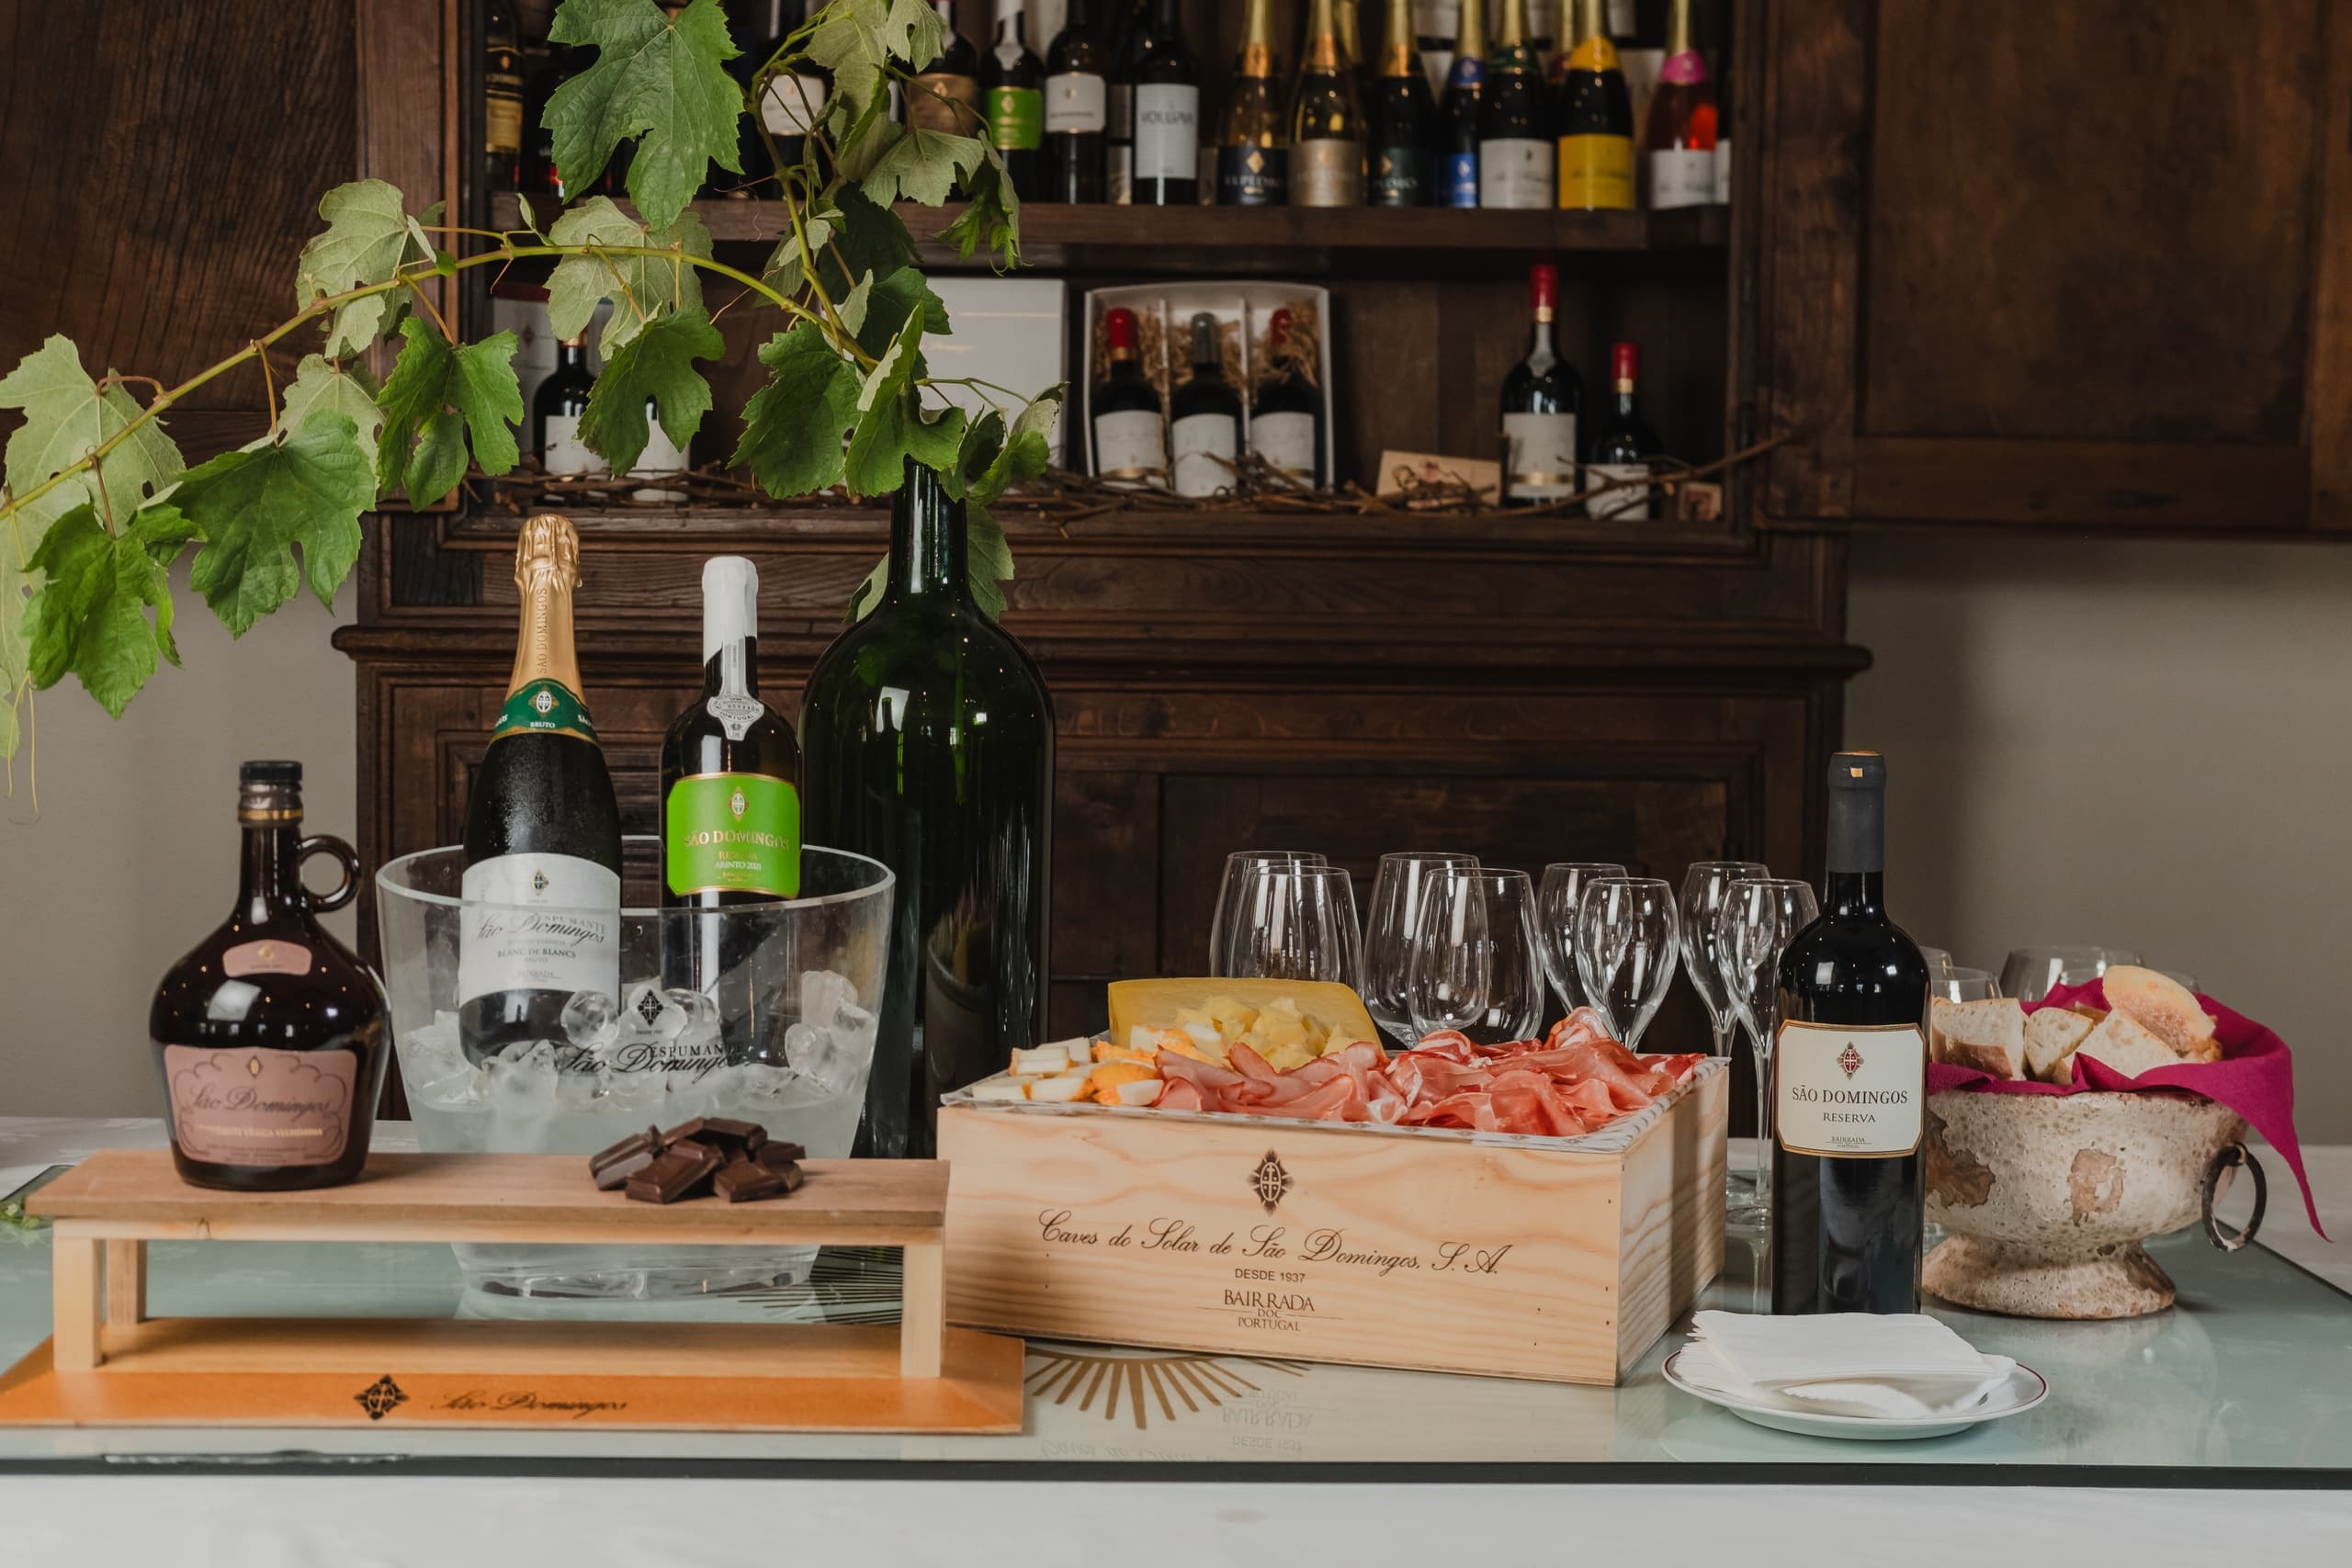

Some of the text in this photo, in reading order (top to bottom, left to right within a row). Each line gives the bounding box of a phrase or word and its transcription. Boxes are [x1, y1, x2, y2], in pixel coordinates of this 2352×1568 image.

[536, 587, 548, 652] DOMINGOS
[684, 829, 790, 850] SÃO DOMINGOS
[506, 912, 605, 948] Domingos
[528, 947, 540, 955] DE
[542, 947, 577, 959] BLANCS
[562, 1041, 607, 1073] São
[1792, 1084, 1908, 1105] SÃO DOMINGOS
[1823, 1111, 1876, 1123] RESERVA
[1831, 1135, 1866, 1144] BAIRRADA
[1038, 1208, 1099, 1243] Caves
[1141, 1217, 1201, 1254] Solar
[1209, 1231, 1235, 1256] de
[1242, 1224, 1286, 1259] São
[1297, 1227, 1421, 1278] Domingos,
[1235, 1268, 1306, 1283] DESDE 1937
[1224, 1289, 1316, 1312] BAIRRADA
[1257, 1308, 1283, 1318] DOC
[1238, 1317, 1301, 1332] PORTUGAL
